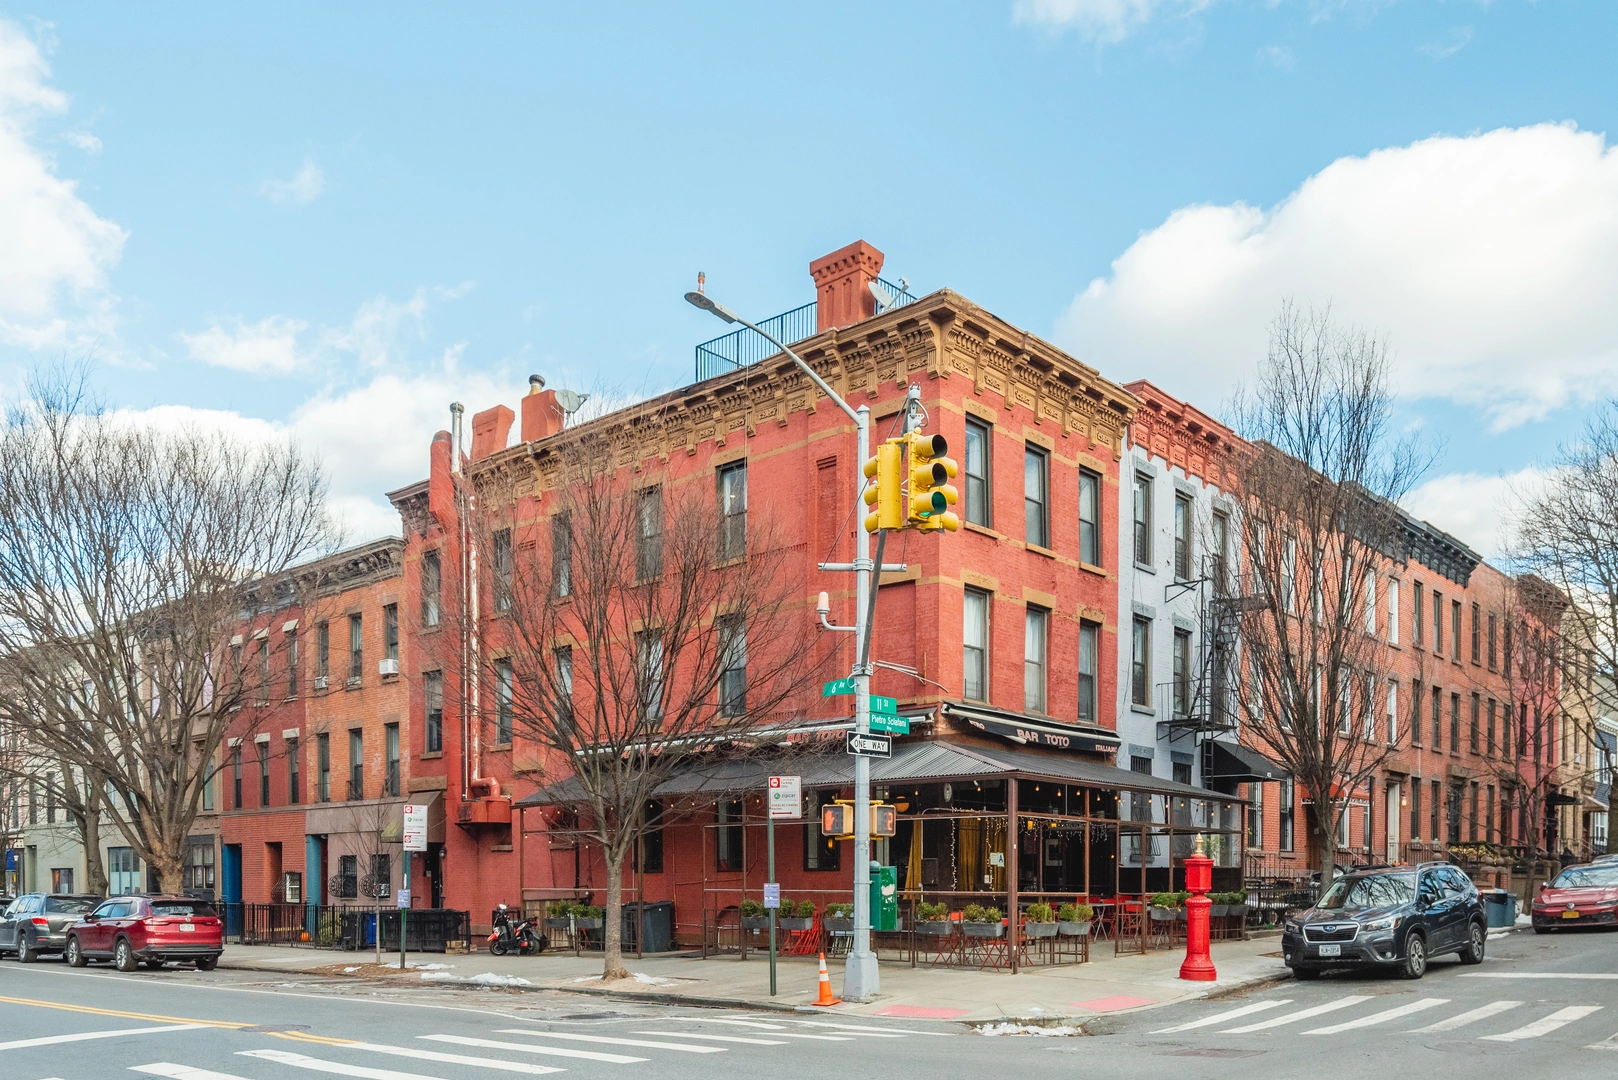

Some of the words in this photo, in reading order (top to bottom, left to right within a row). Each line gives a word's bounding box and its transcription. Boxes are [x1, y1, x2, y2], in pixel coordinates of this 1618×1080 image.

[831, 682, 837, 694] 6
[876, 698, 882, 711] 11
[883, 699, 889, 708] St
[871, 714, 887, 725] Pietro
[816, 728, 847, 742] TOTO
[1016, 728, 1039, 743] BAR
[1044, 733, 1070, 747] TOTO
[854, 740, 867, 749] ONE
[872, 742, 886, 751] WAY
[887, 812, 894, 831] 2
